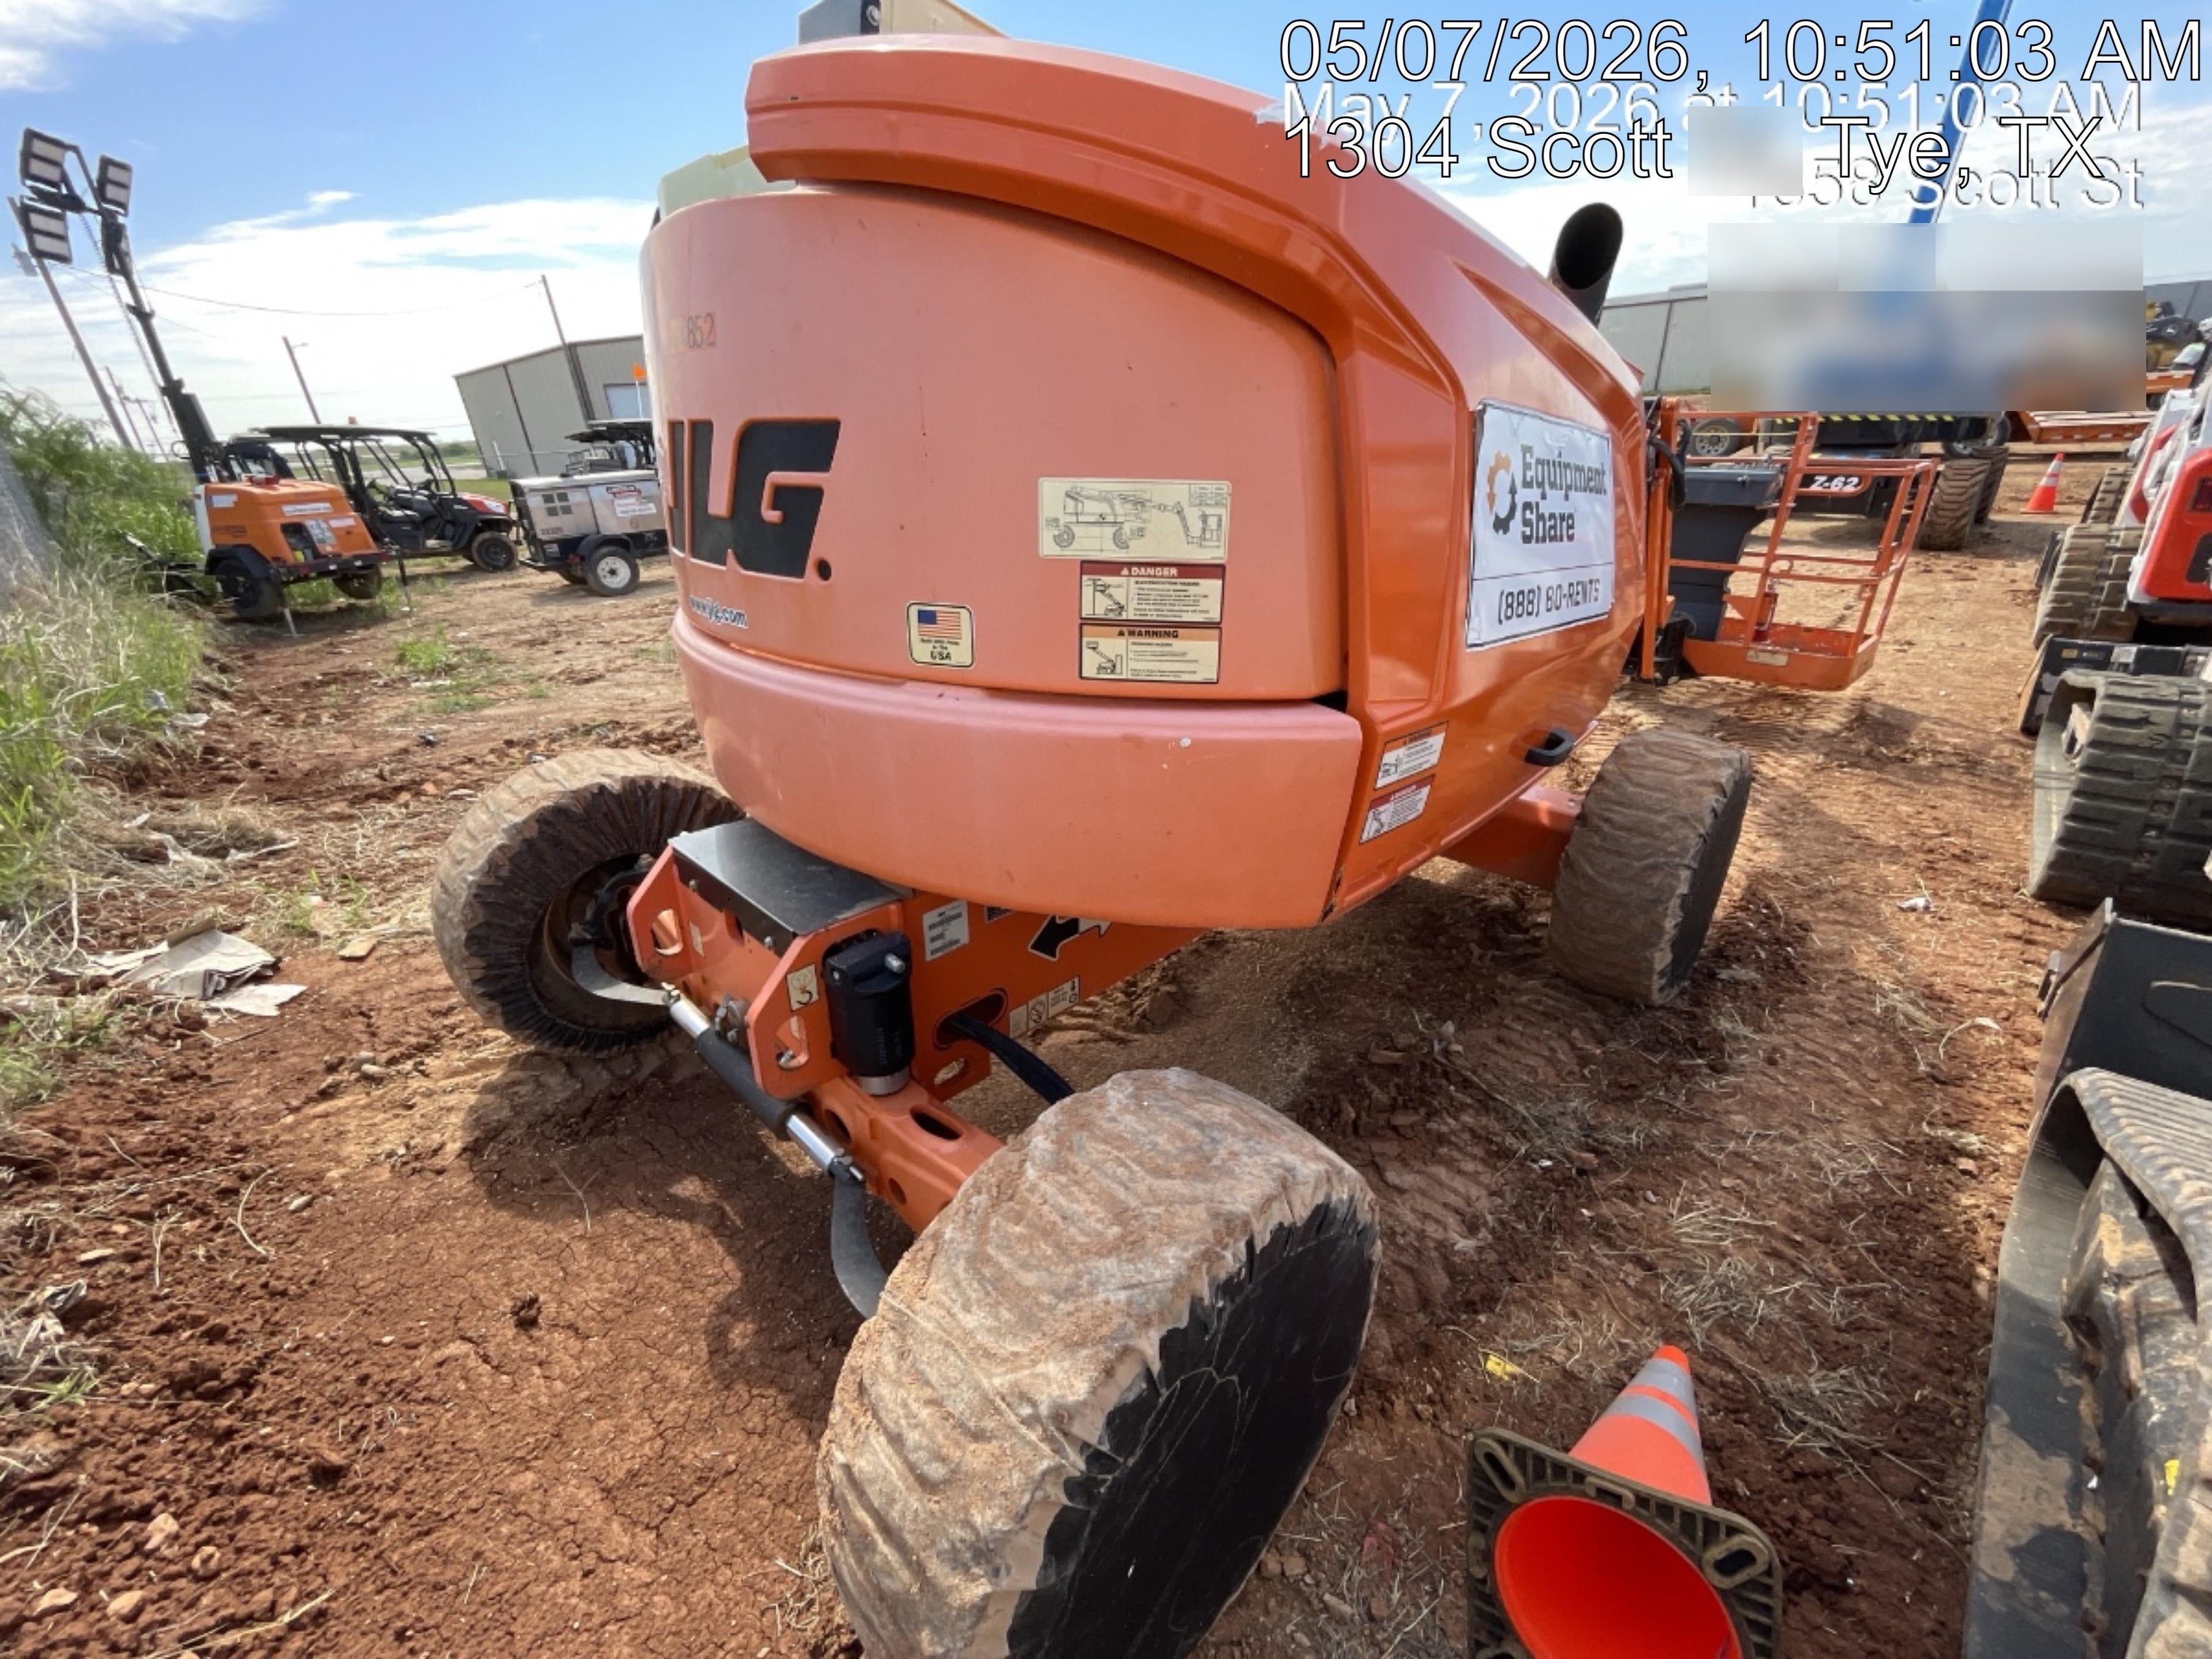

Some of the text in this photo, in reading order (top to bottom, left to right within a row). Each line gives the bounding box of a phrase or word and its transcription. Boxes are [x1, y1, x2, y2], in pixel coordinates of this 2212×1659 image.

[1521, 444, 1607, 501] Equipment
[1809, 475, 1859, 490] Z-62
[1521, 501, 1575, 544] Share
[1131, 567, 1179, 576] DANGER
[1498, 584, 1542, 626] (888)
[1128, 629, 1179, 639] WARNING
[930, 651, 952, 661] USA
